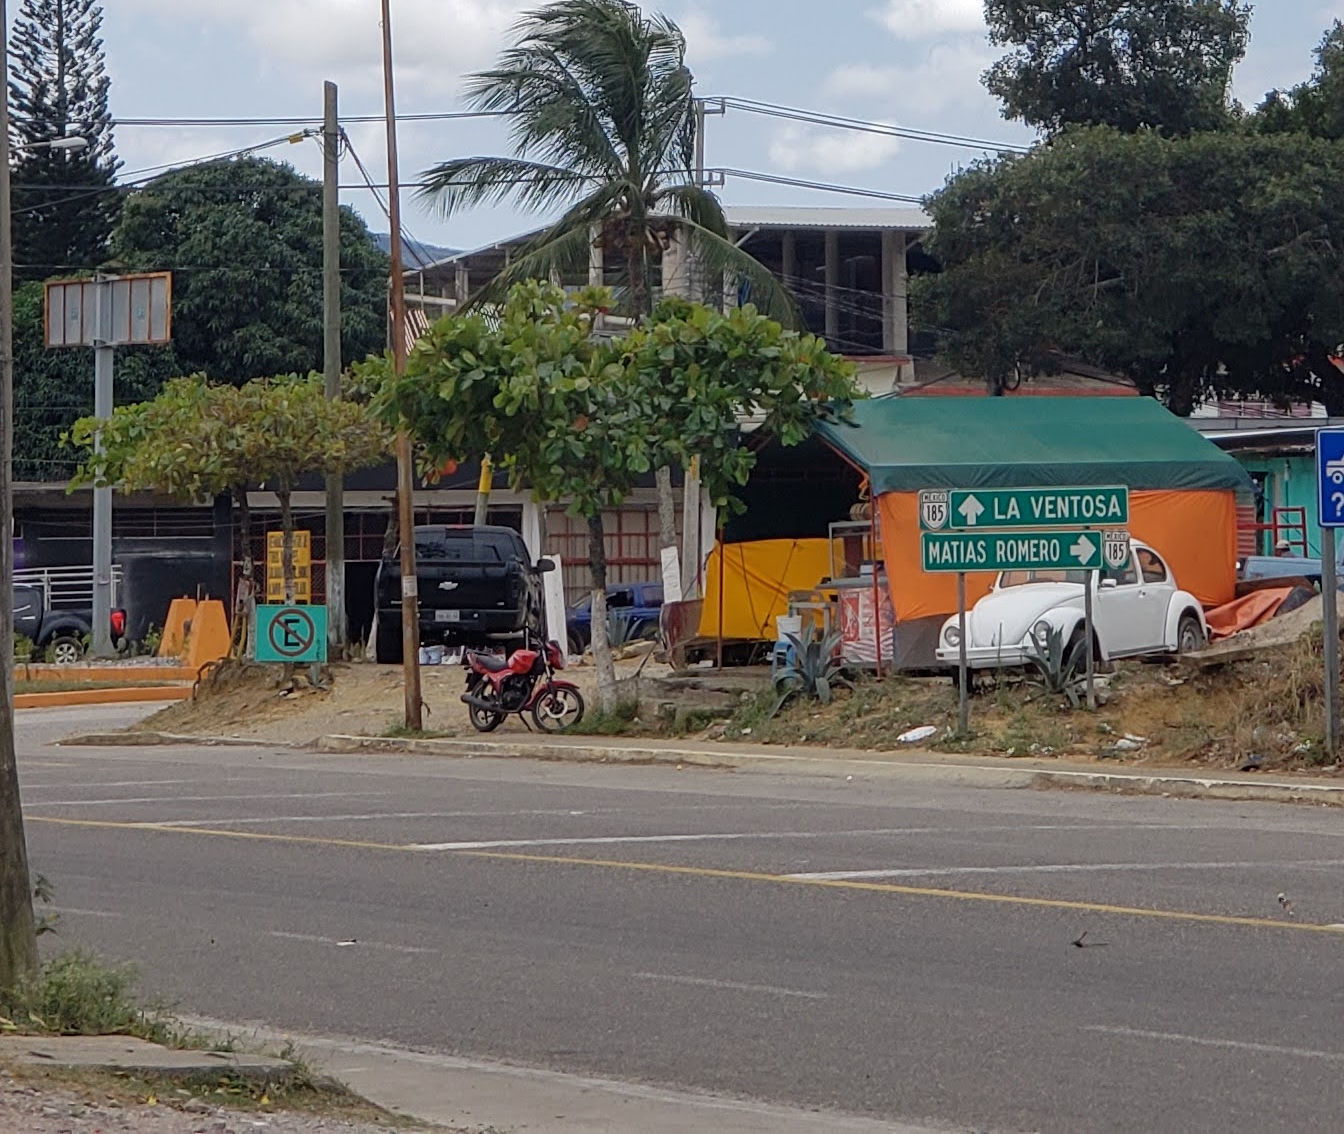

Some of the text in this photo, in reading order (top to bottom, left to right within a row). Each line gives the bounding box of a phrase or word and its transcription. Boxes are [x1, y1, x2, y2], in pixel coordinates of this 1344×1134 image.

[924, 493, 946, 502] MEXICO
[926, 505, 944, 522] 185
[993, 494, 1122, 520] LA VENTOSA
[1106, 532, 1128, 540] MEXICO
[928, 538, 1061, 564] MATIAS ROMERO
[1108, 543, 1124, 560] 185
[284, 618, 301, 647] E
